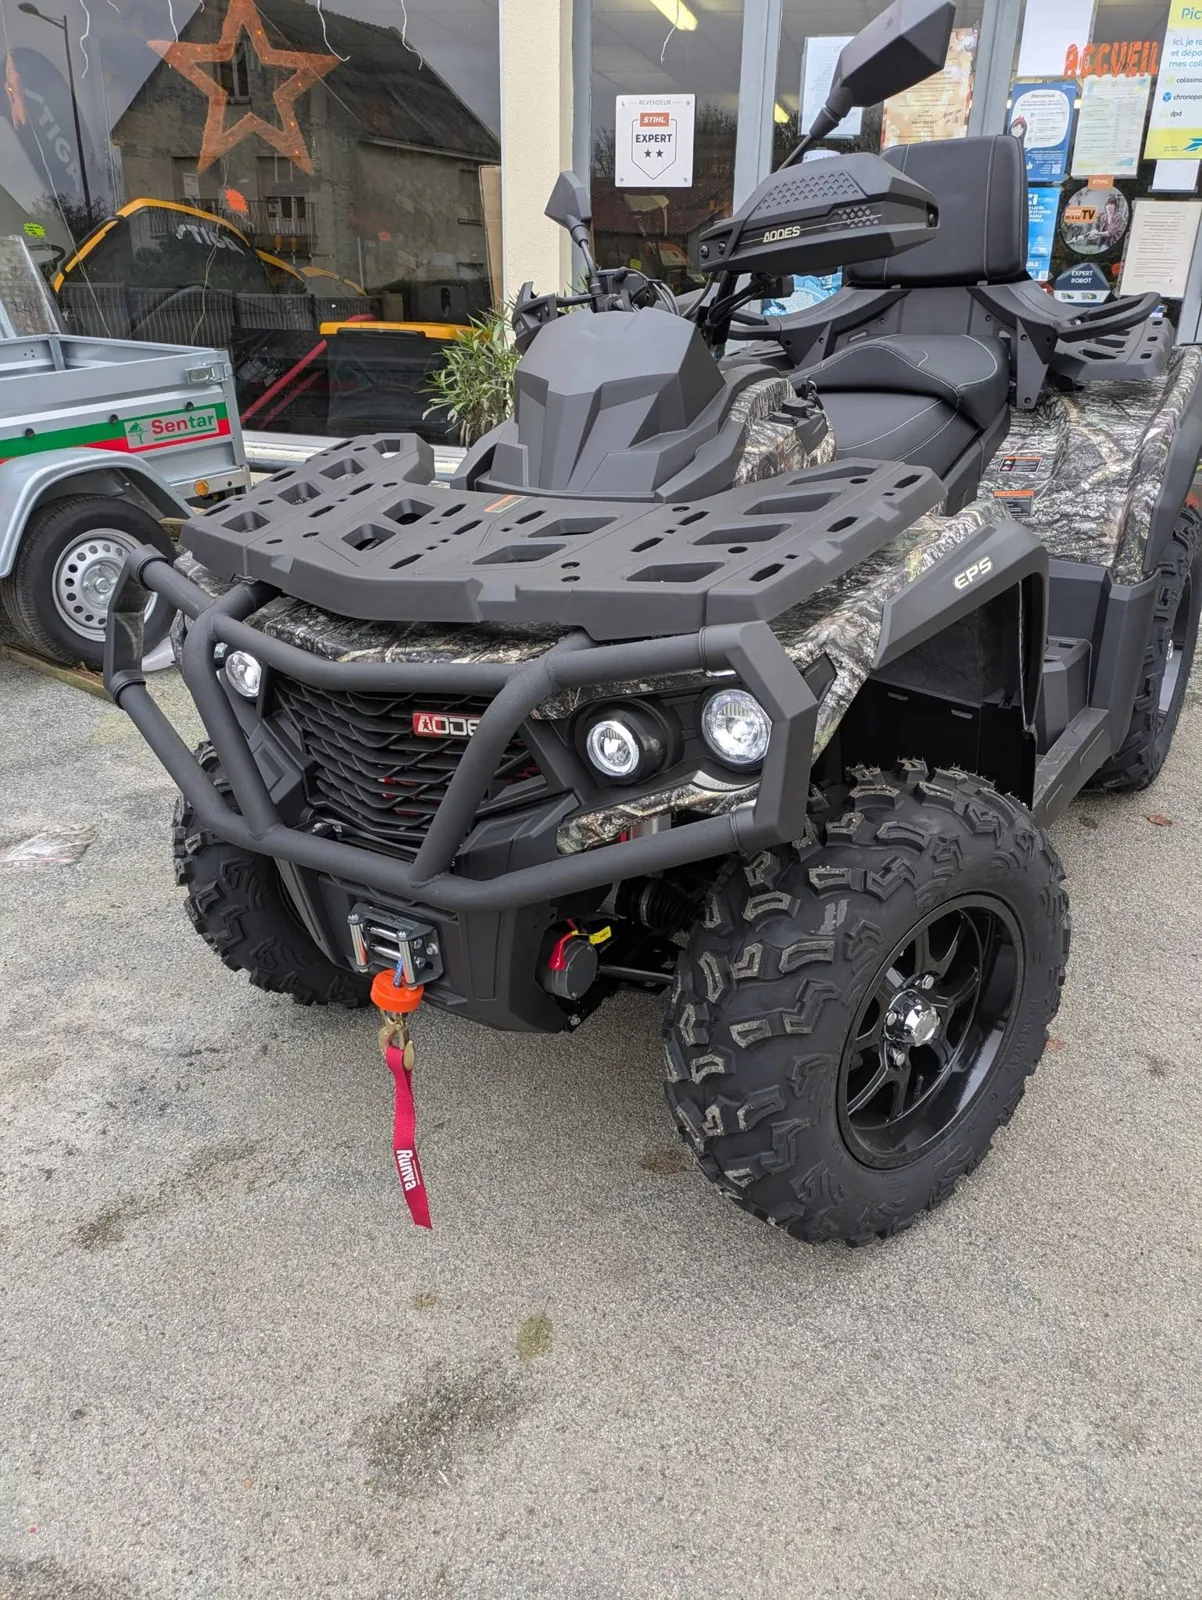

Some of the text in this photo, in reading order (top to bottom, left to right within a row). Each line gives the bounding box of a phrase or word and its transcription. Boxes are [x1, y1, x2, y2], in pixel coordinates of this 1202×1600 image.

[1185, 38, 1194, 47] je
[1170, 111, 1182, 119] dpd
[635, 133, 673, 143] EXPERT
[1082, 209, 1096, 220] TV
[763, 225, 801, 243] AODES
[151, 414, 214, 435] Sentar
[954, 556, 993, 590] EPS
[396, 1149, 417, 1191] Runva
